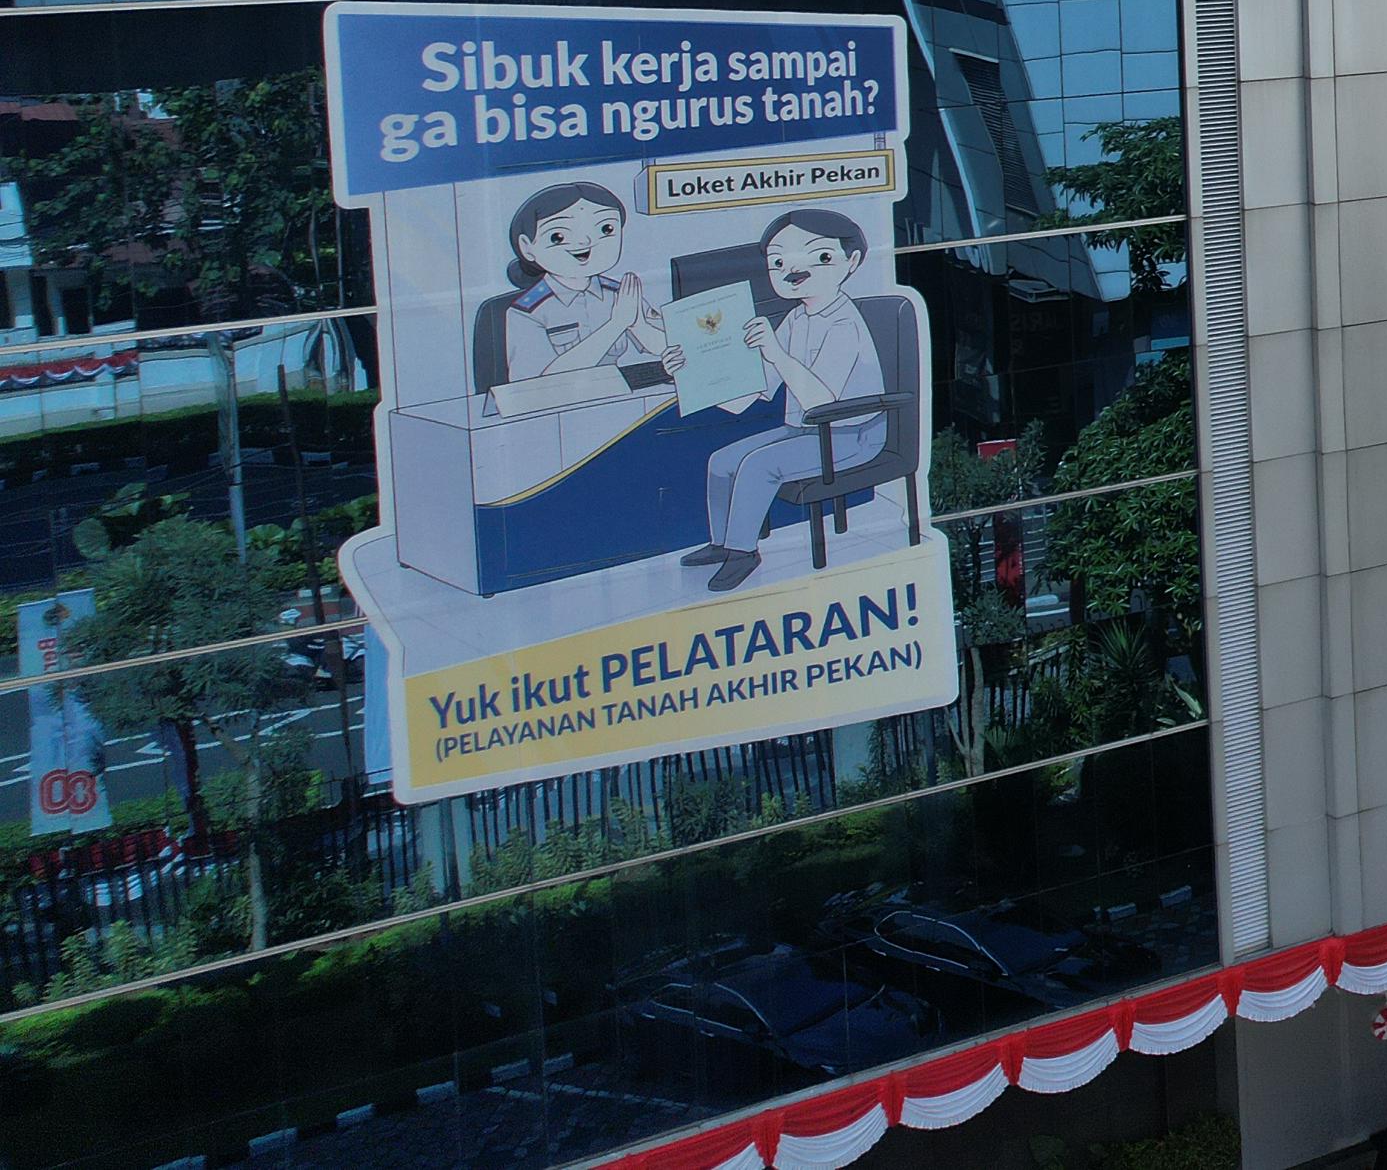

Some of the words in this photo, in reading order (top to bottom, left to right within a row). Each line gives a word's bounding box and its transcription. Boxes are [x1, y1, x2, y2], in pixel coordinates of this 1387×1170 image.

[421, 41, 589, 93] Sibuk
[602, 39, 719, 93] kerja
[727, 41, 857, 93] sampai
[380, 109, 458, 162] ga
[475, 93, 588, 145] bisa
[602, 91, 755, 142] ngurus
[761, 80, 879, 122] tanah?
[667, 173, 736, 198] Loket
[740, 168, 804, 192] Akhir
[810, 163, 880, 187] Pekan
[429, 685, 500, 730] Yuk
[510, 665, 592, 714] ikut
[600, 583, 919, 694] PELATARAN!
[434, 707, 597, 763] (PELAYANAN
[601, 686, 700, 726] TANAH
[706, 667, 799, 707] AKHIR
[805, 641, 923, 690] PEKAN)
